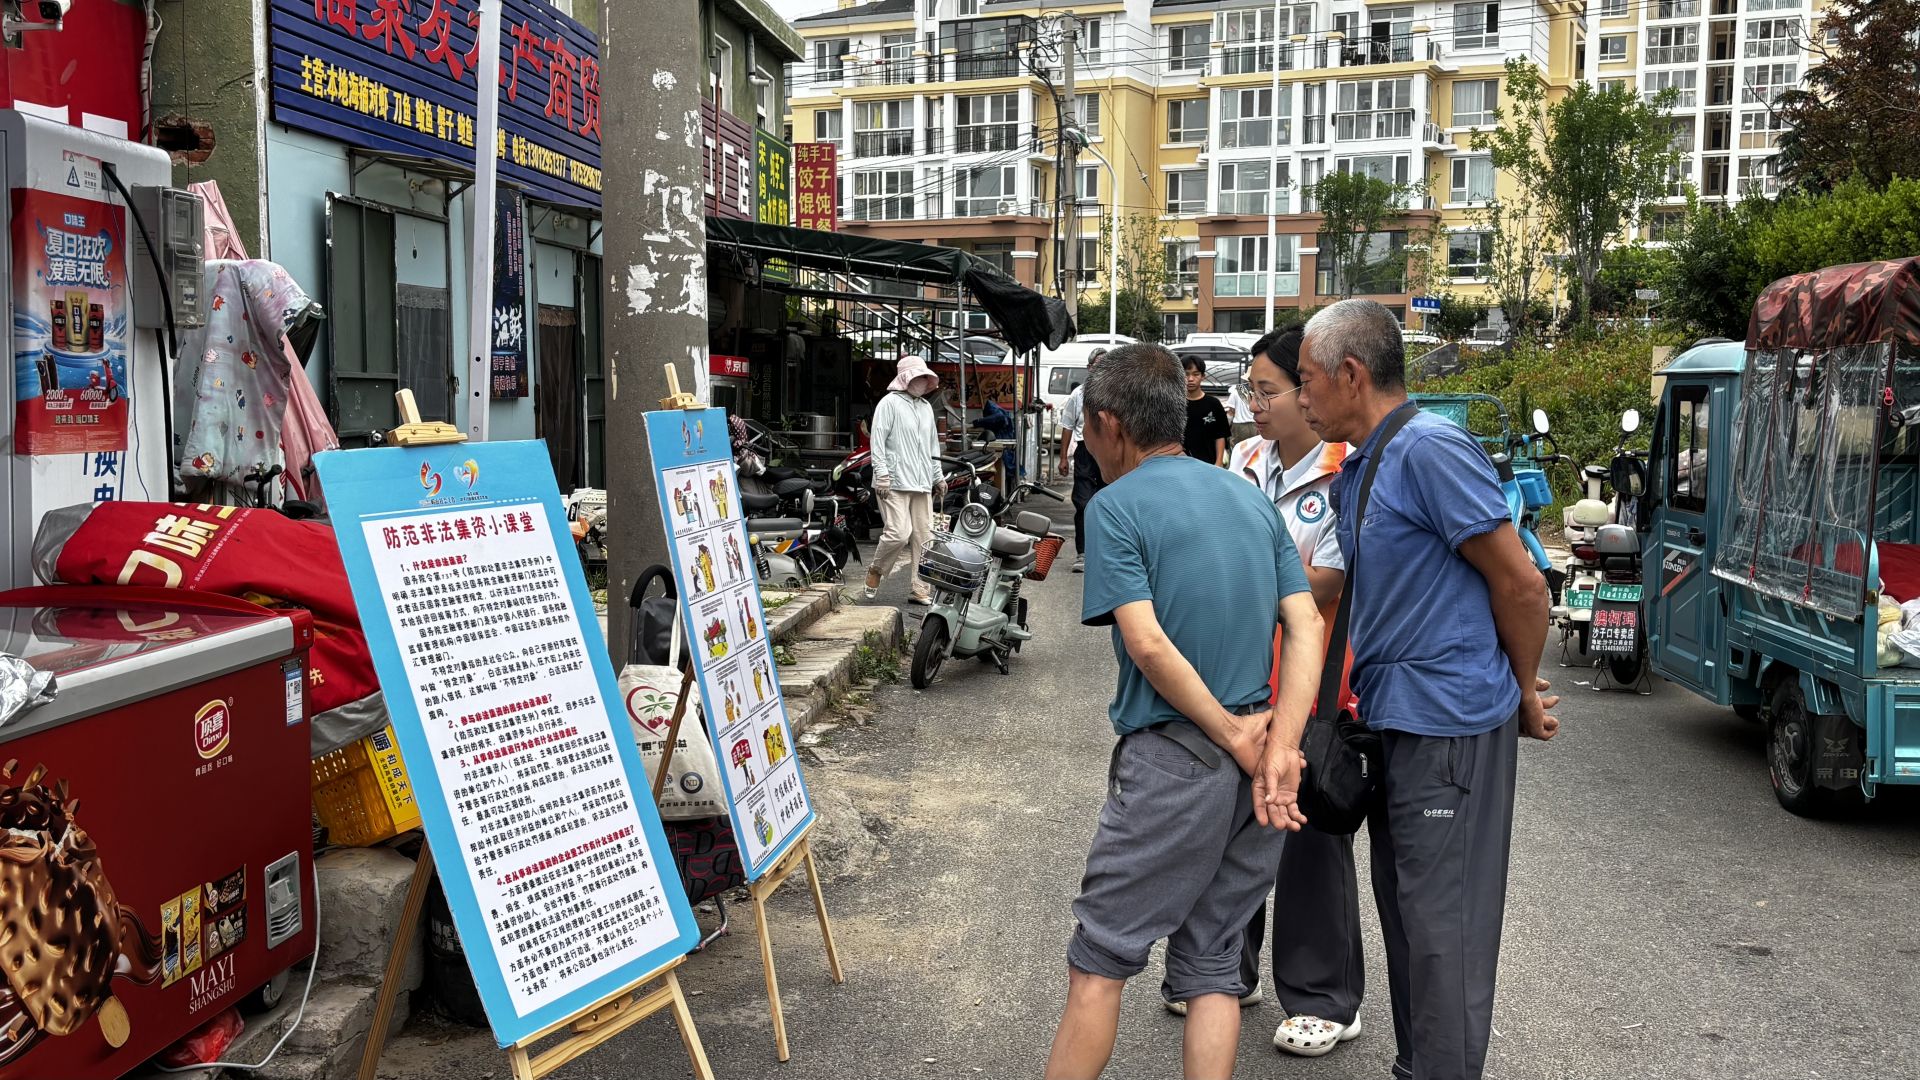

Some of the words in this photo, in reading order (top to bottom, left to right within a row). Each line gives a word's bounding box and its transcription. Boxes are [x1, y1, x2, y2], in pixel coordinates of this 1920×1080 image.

[393, 91, 411, 127] 刀鱼
[798, 145, 832, 163] 纯手工
[798, 166, 832, 189] 饺子
[798, 193, 832, 215] 馄饨
[64, 213, 86, 227] 口味王
[46, 227, 106, 261] 夏日狂欢
[46, 258, 109, 286] 爱意无限
[495, 304, 522, 351] 海鲜
[382, 511, 535, 549] 防范非法集资小课堂
[400, 553, 467, 571] 1、什么是非法集资?
[1593, 609, 1636, 627] 澳柯玛
[1592, 628, 1635, 640] 沙子口专卖店
[412, 651, 453, 666] 汇管理部门。
[200, 709, 224, 739] 顶喜
[477, 866, 496, 880] 责任。
[190, 953, 235, 1000] MAYI
[189, 975, 236, 1015] SHANGSHU
